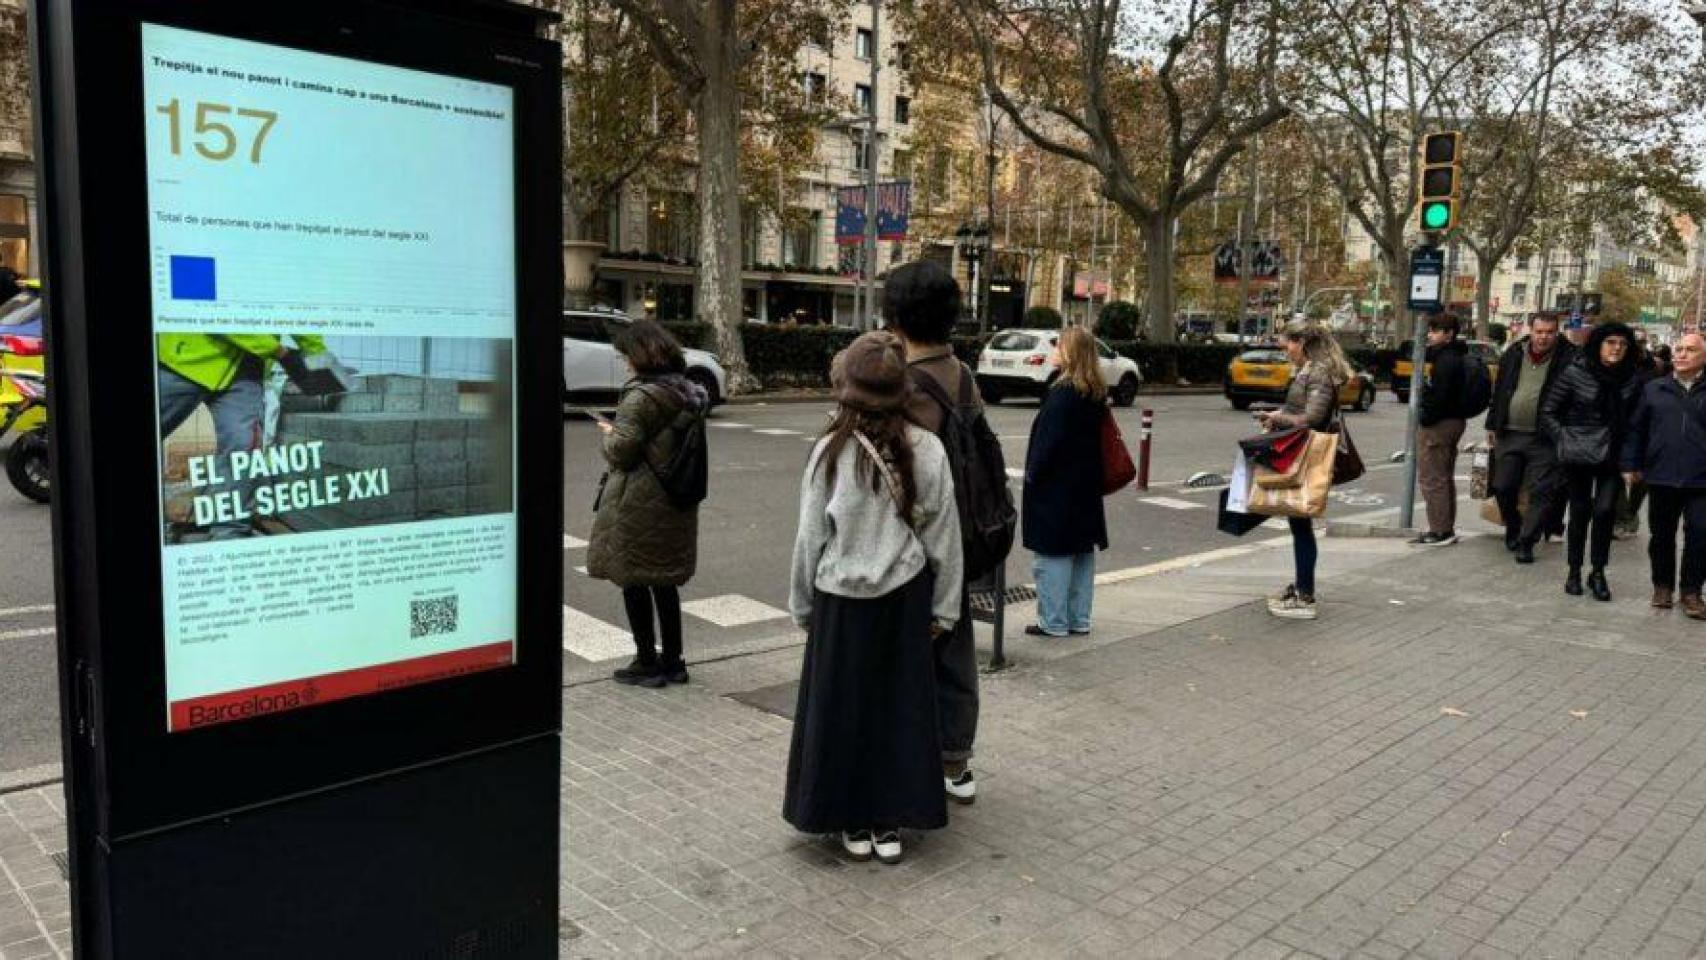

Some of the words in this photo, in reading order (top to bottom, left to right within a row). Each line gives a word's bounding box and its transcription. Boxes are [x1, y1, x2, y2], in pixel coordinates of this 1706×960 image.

[152, 56, 203, 74] Trepitja
[206, 66, 218, 75] el
[222, 69, 244, 79] nou
[248, 72, 282, 86] panot
[337, 86, 357, 99] cap
[155, 97, 278, 164] 157
[154, 210, 182, 222] Total
[184, 215, 198, 223] de
[201, 217, 250, 228] persones
[253, 221, 272, 230] que
[274, 221, 294, 231] han
[188, 454, 225, 488] EL
[230, 440, 323, 481] PANOT
[194, 490, 250, 527] DEL
[255, 475, 341, 516] SEGLE
[346, 467, 390, 501] XXI
[189, 688, 299, 727] Barcelona
